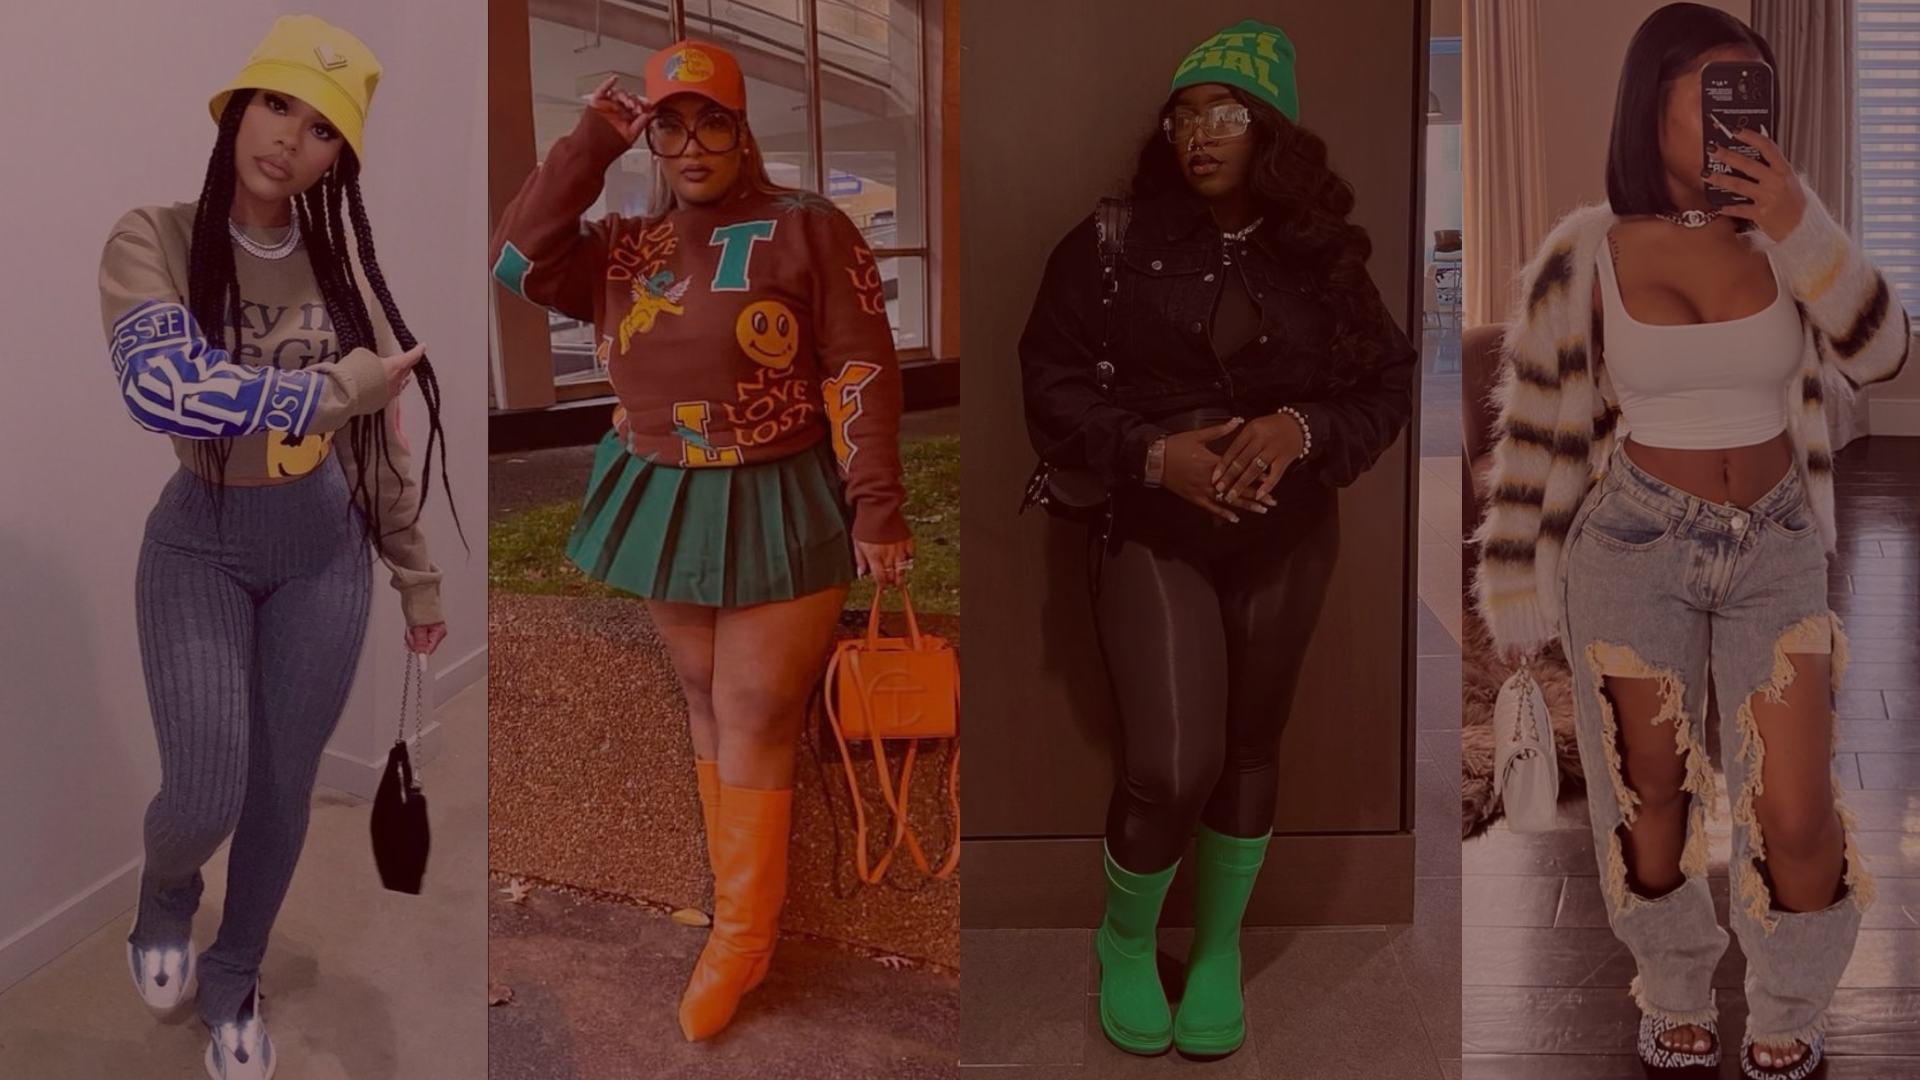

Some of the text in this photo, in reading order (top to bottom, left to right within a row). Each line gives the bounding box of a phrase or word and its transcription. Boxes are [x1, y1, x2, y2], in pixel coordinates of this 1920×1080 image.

[709, 219, 778, 292] T
[721, 380, 809, 425] LOVE
[734, 403, 814, 446] LOST
